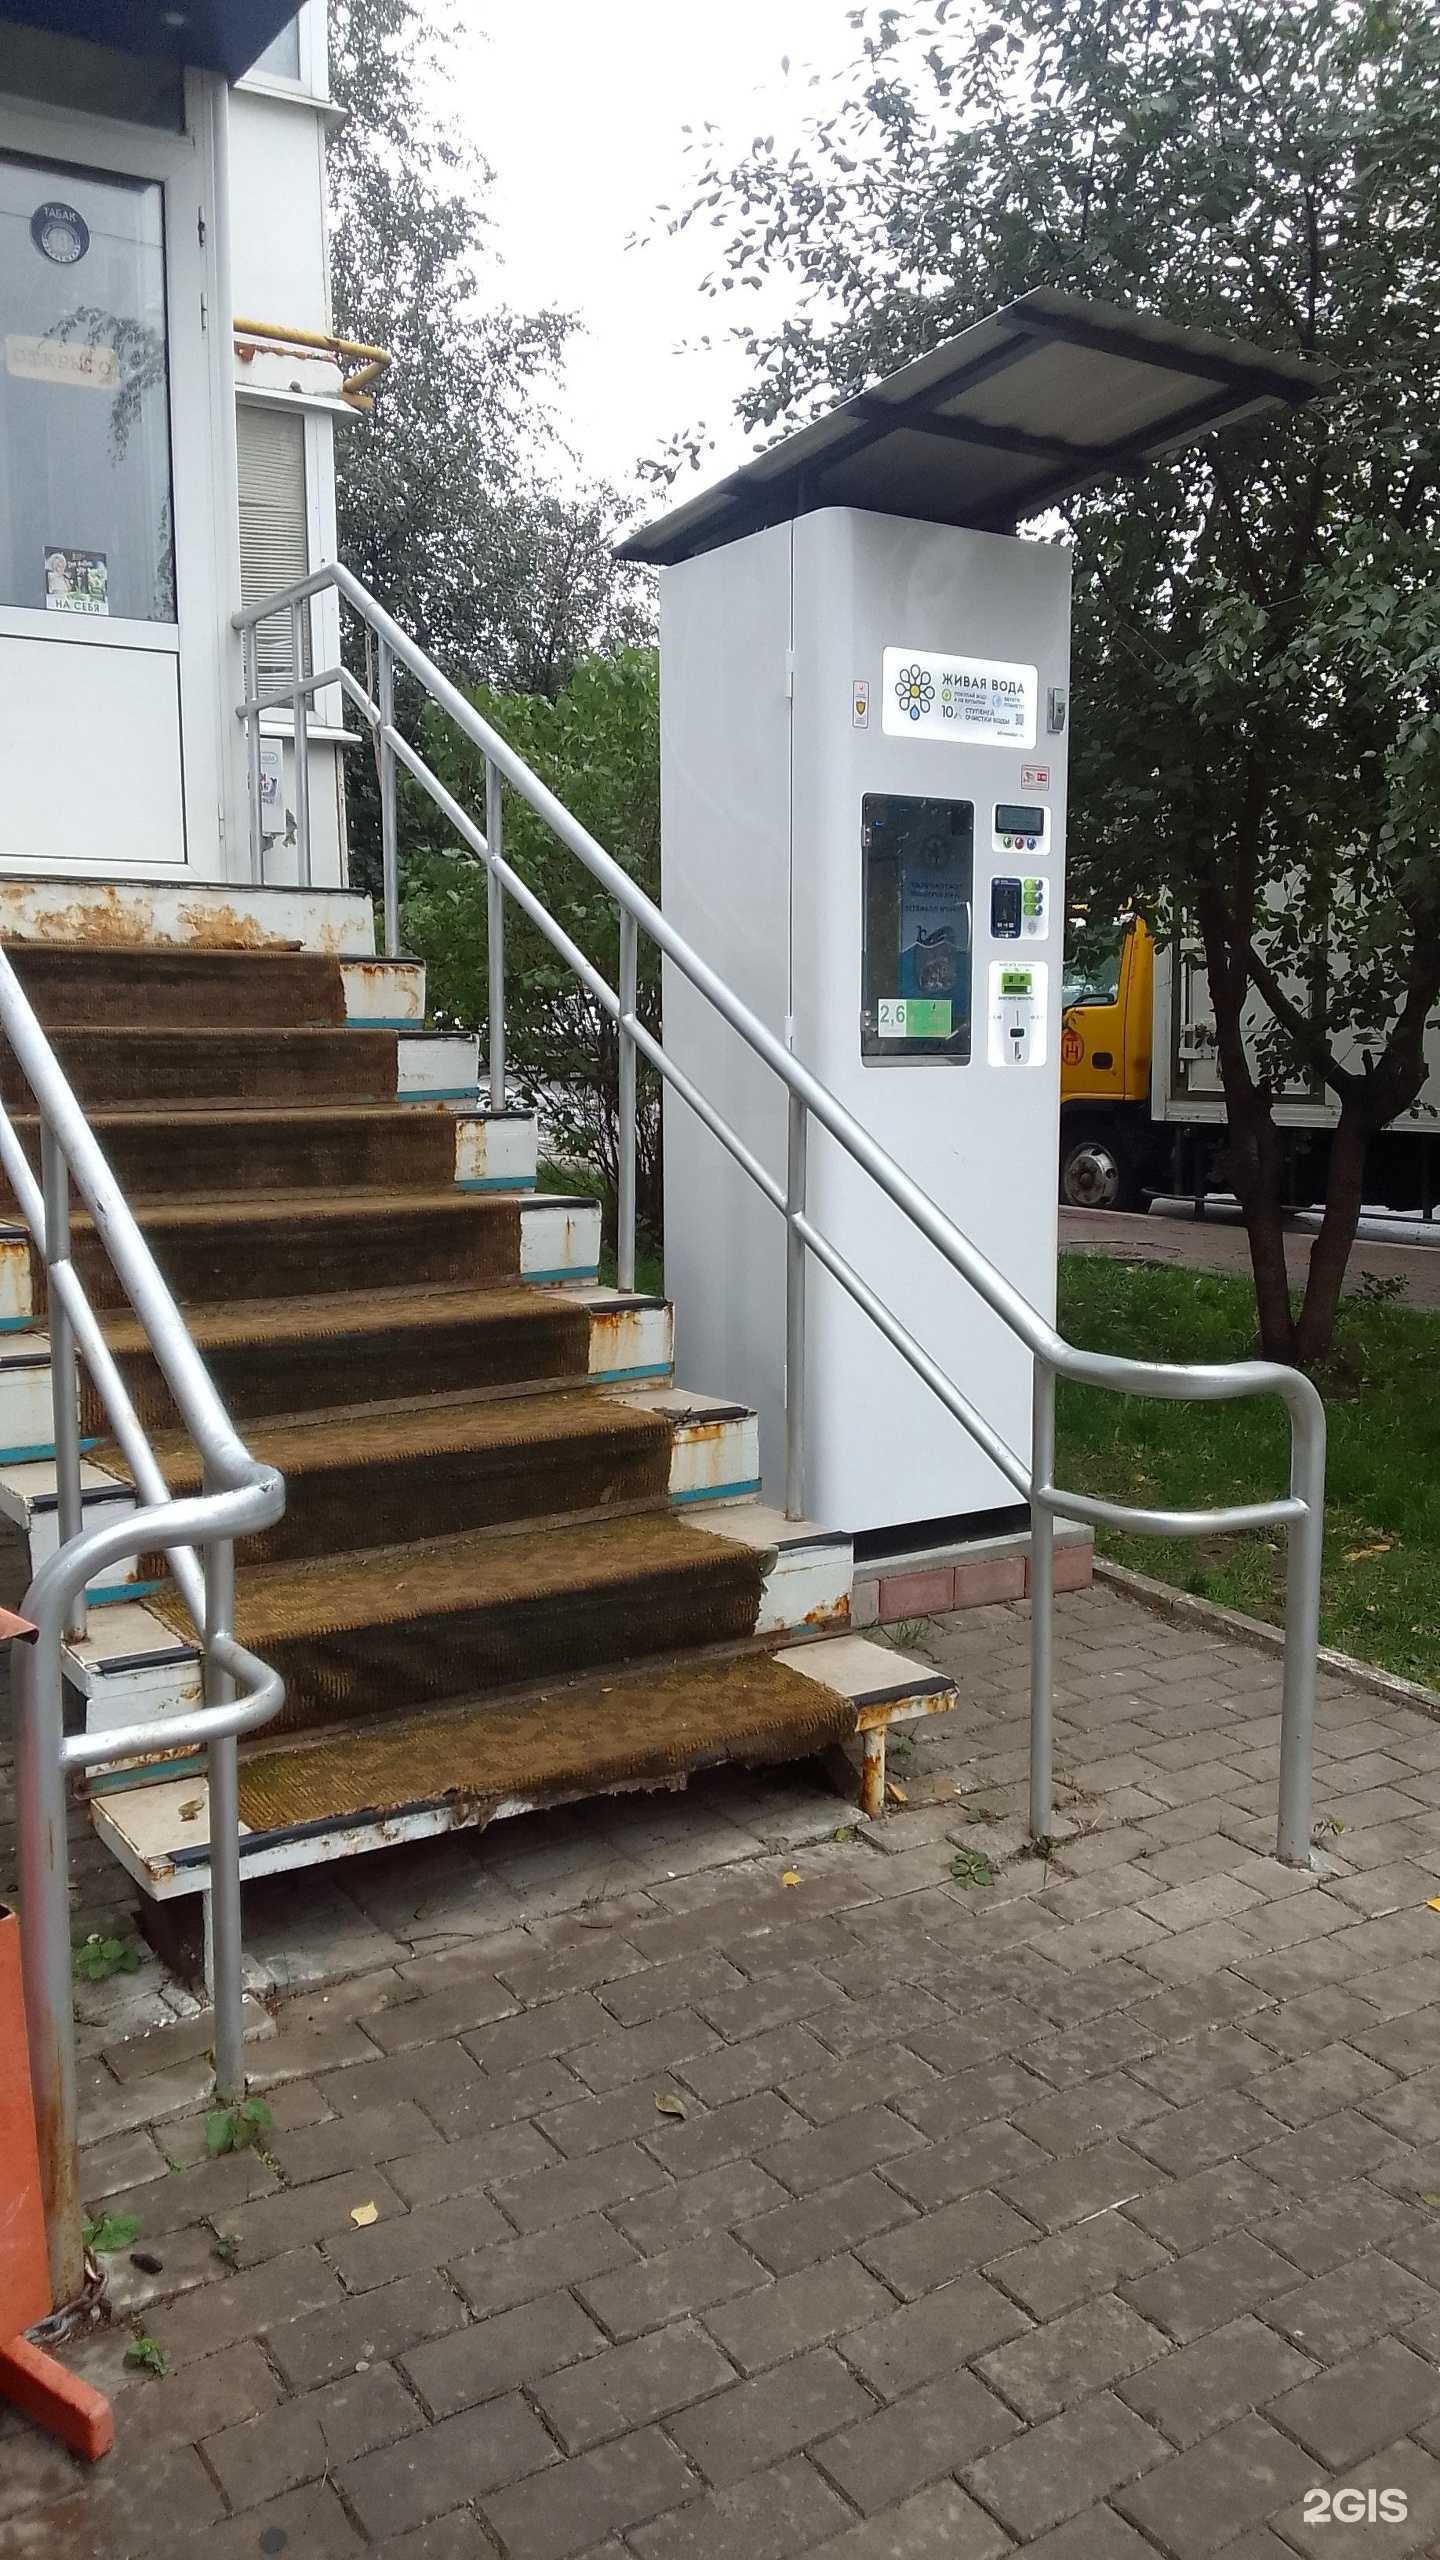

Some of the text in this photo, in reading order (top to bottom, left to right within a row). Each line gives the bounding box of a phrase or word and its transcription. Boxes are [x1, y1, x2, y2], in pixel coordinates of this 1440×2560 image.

[43, 207, 77, 221] ТАБАК
[55, 600, 100, 612] НА СЕБЯ
[942, 673, 1025, 695] ЖИВАЯ ВОДА
